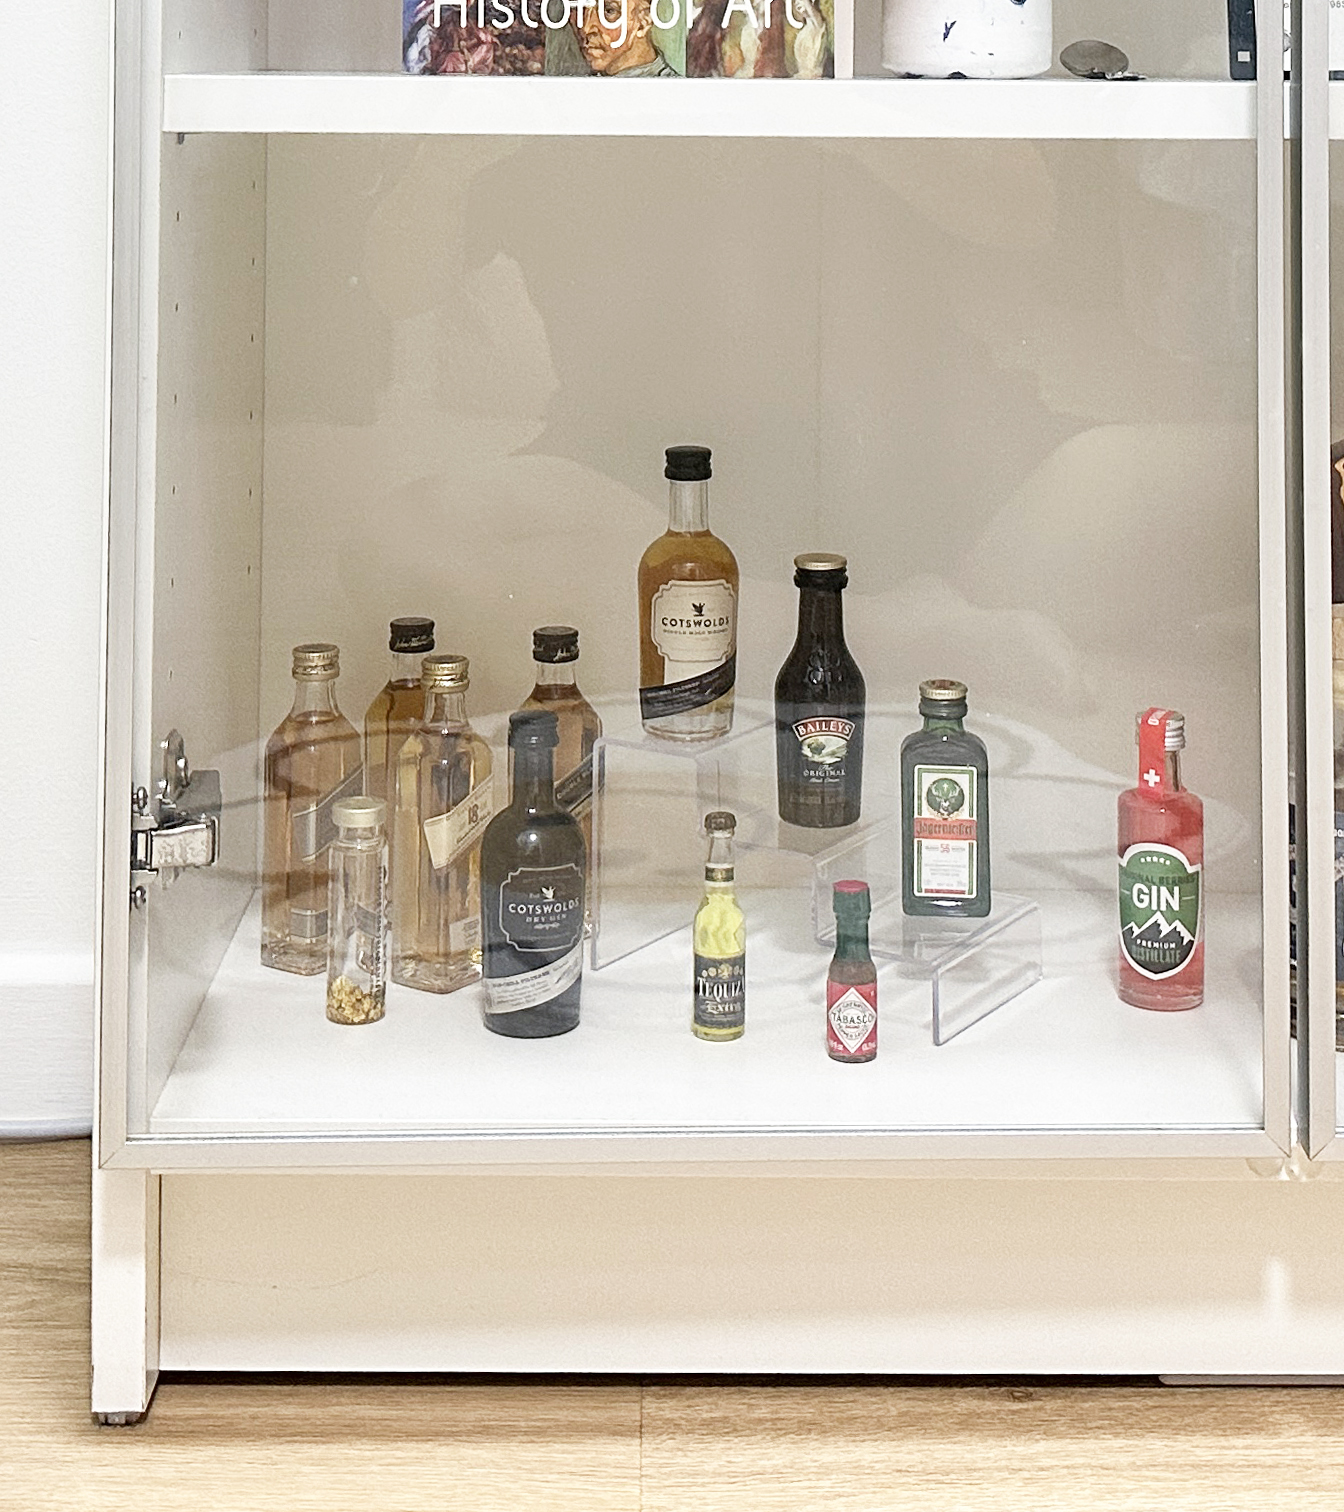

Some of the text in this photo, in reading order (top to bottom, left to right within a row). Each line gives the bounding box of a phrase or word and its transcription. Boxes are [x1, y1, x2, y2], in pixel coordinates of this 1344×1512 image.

[661, 616, 730, 629] COTSWOLDS
[797, 720, 851, 736] BAILEYS
[1132, 884, 1181, 911] GIN
[508, 897, 580, 915] COTSWOLDS
[1136, 938, 1176, 949] PREMIUM
[831, 1011, 875, 1025] TABASCO
